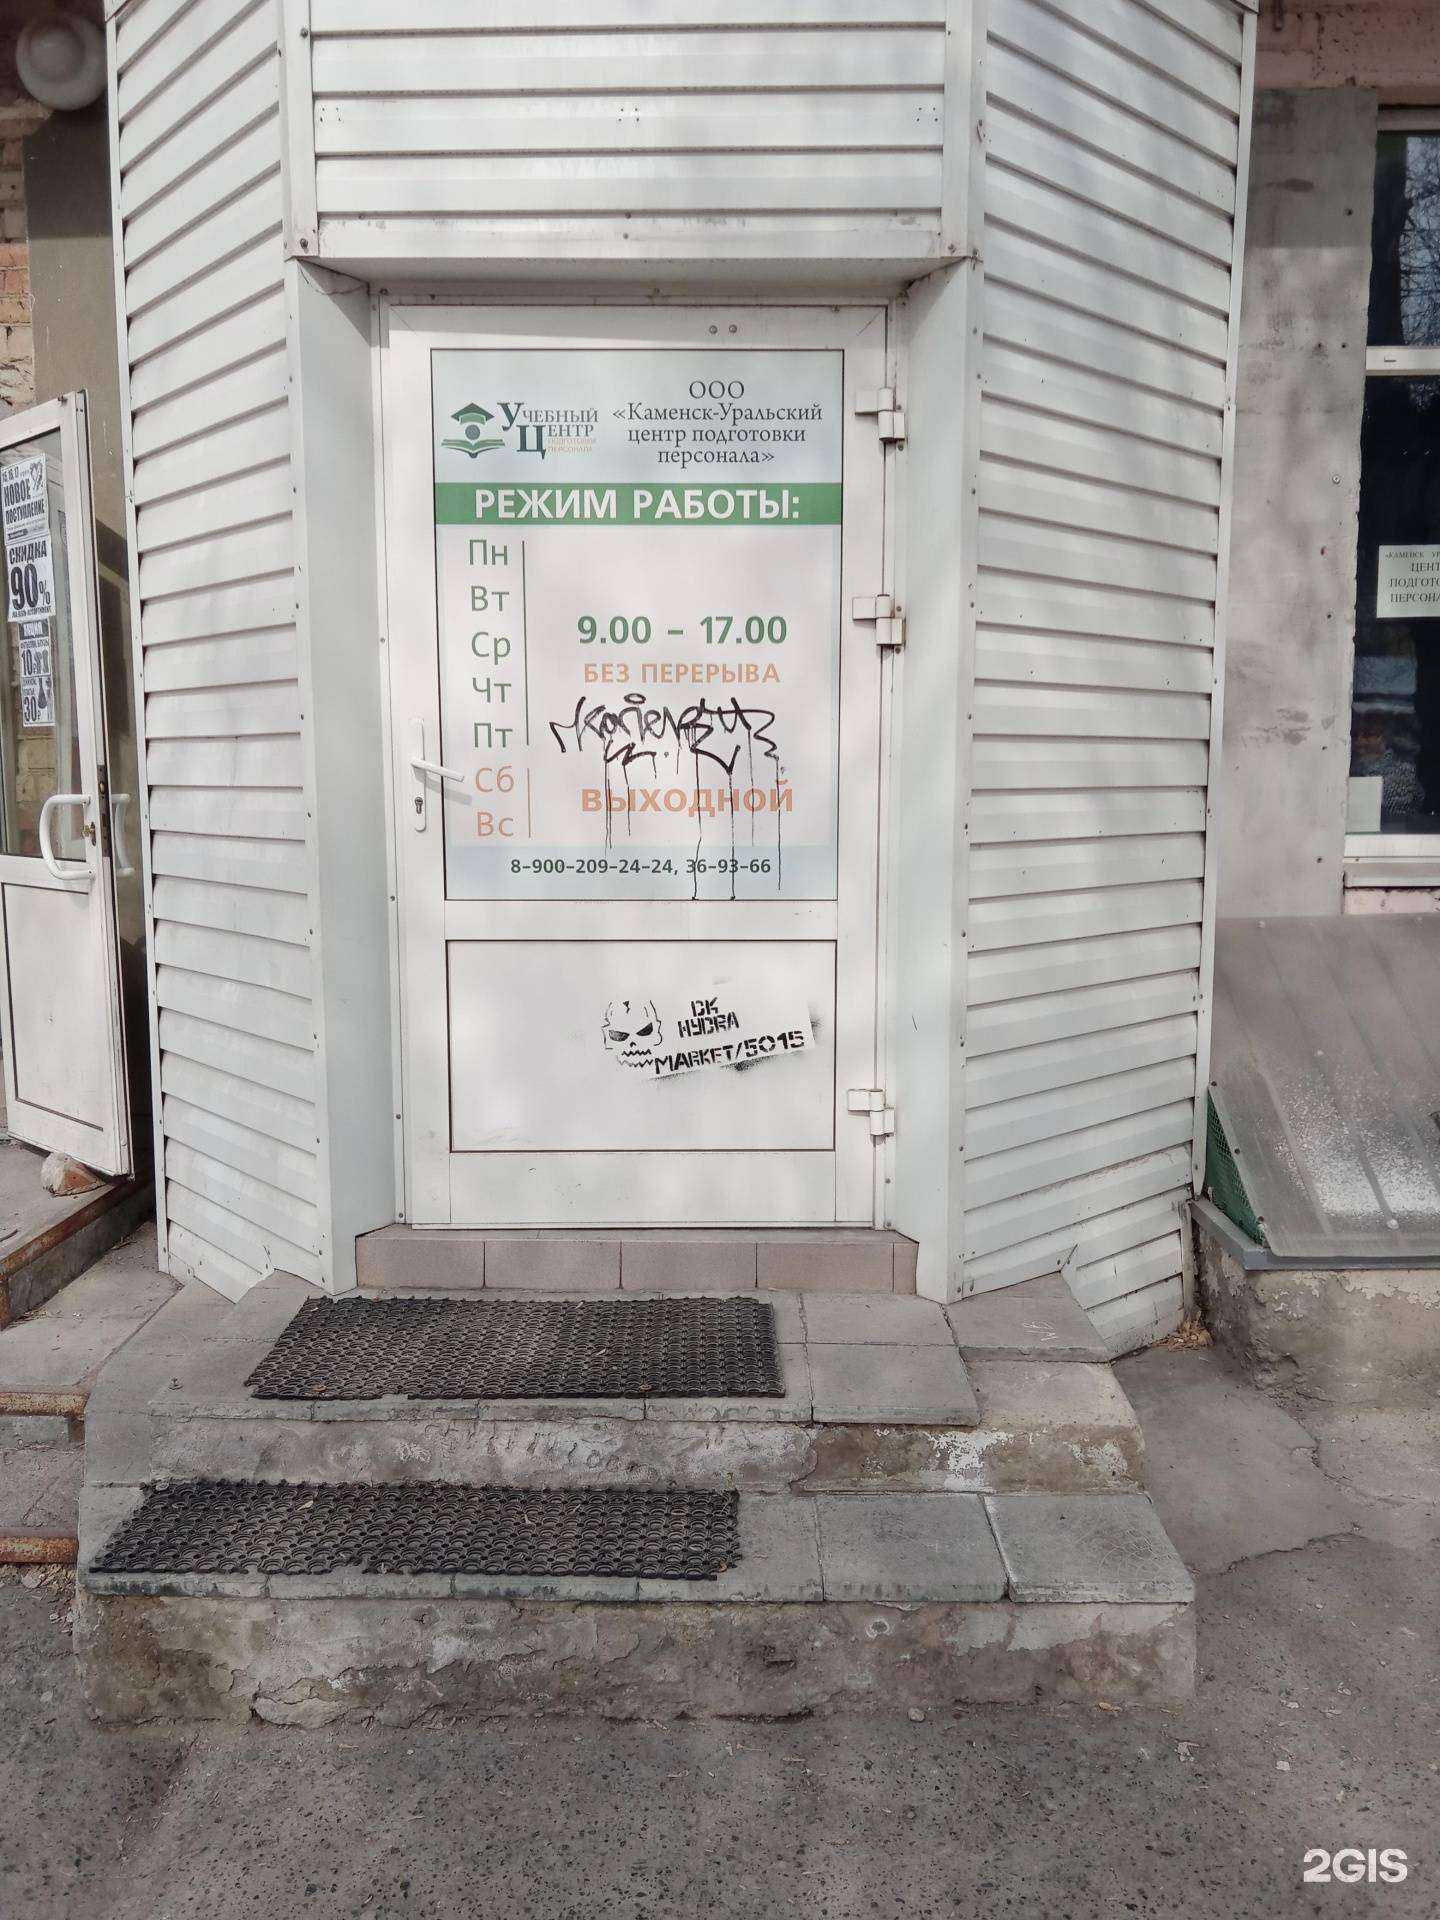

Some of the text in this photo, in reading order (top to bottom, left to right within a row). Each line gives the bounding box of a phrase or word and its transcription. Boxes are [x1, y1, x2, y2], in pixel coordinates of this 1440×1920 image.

[688, 380, 745, 399] ООО
[612, 402, 823, 426] «Каменск-Уральский
[516, 424, 594, 460] ЦЕНТР
[627, 429, 806, 447] центр подготовки
[657, 450, 775, 468] персонала»
[4, 478, 31, 507] НОВОЕ
[474, 489, 801, 520] РЕЖИМ РАБОТЫ:
[6, 499, 45, 525] ПОСТУПЛЕНИЕ
[9, 540, 47, 565] СКИДКА
[469, 539, 508, 565] Пн
[471, 585, 510, 611] Вт
[577, 615, 652, 644] 9.00
[699, 615, 788, 644] 17.00
[471, 631, 511, 665] Ср
[583, 662, 781, 683] БЕЗ ПЕРЕРЫВА
[472, 677, 512, 703] Чт
[474, 722, 513, 748] Пт
[475, 765, 514, 793] Сб
[581, 779, 794, 817] ВЫХОДНОЙ
[477, 811, 514, 837] Вс
[510, 858, 772, 876] 8-900-209-24-24, 36-93-66
